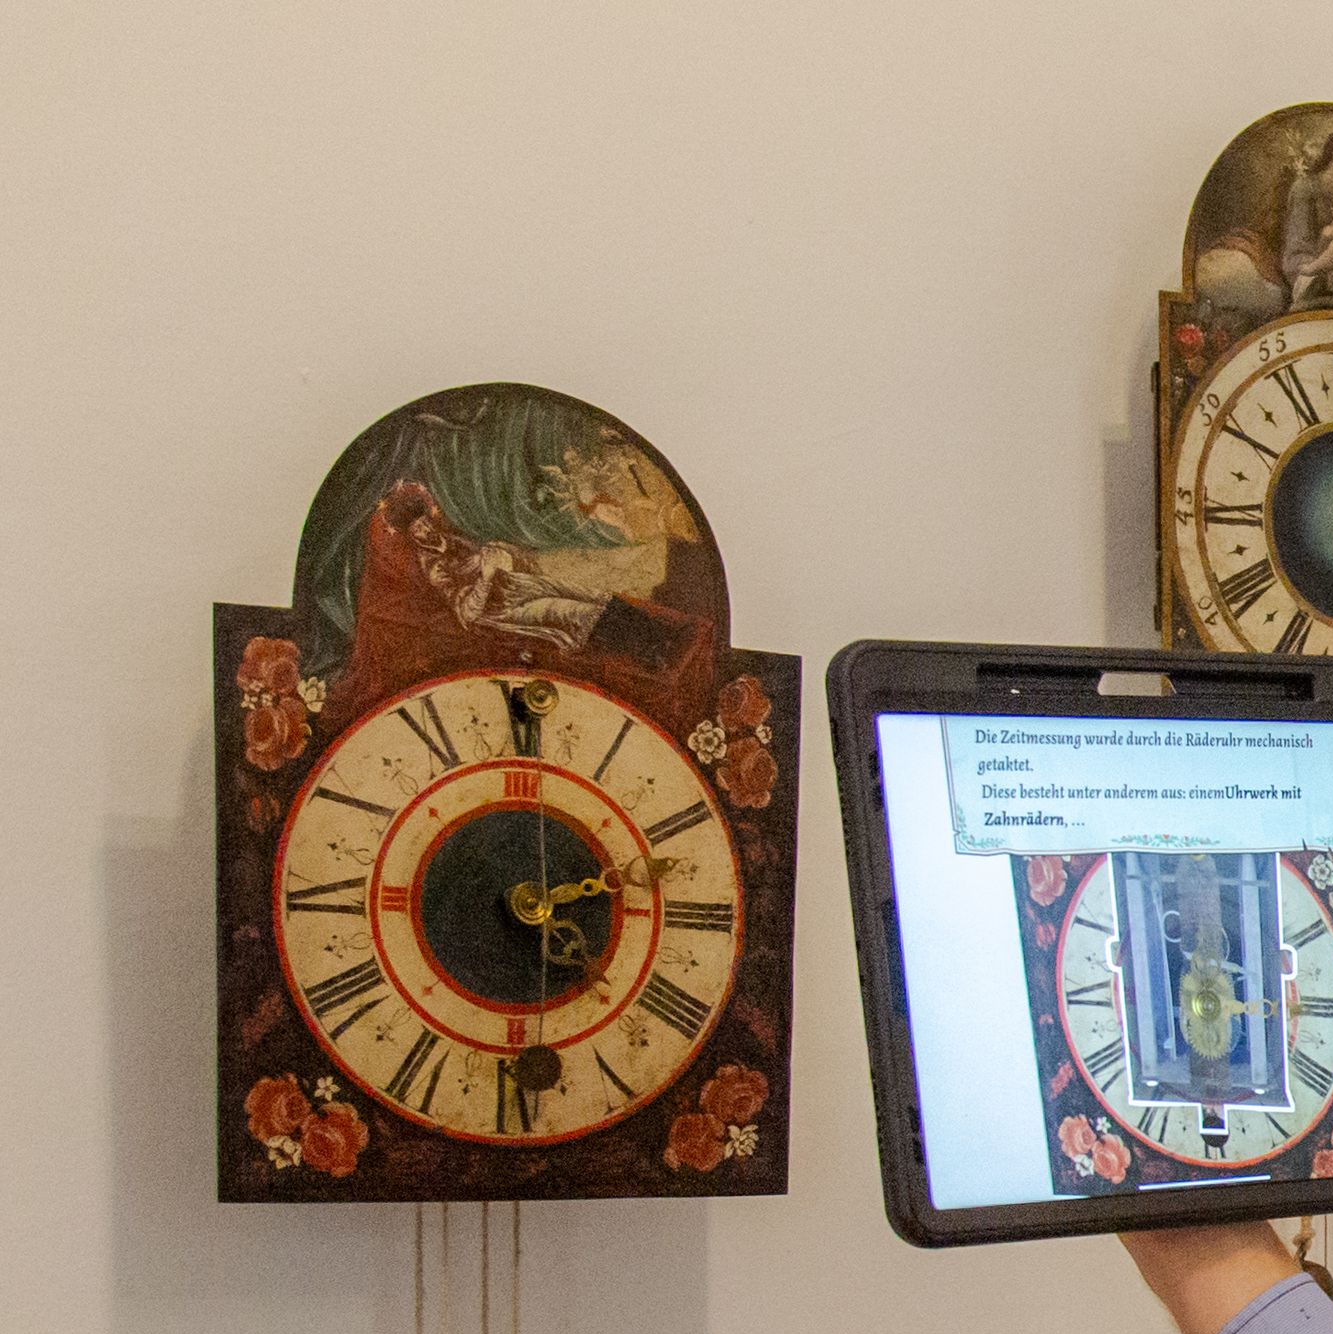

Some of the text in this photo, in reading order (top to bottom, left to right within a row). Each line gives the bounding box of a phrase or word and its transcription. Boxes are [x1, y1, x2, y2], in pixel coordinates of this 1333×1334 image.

[1258, 332, 1287, 361] 55
[975, 729, 1314, 749] Die Zeitmessung wurde durch die Räderuhr mechanisch
[977, 756, 1034, 775] getaktet.
[982, 784, 1016, 799] Diese
[1020, 784, 1064, 799] besteht
[1068, 786, 1102, 799] unter
[1104, 784, 1158, 799] anderem
[1161, 789, 1186, 800] aus:
[1281, 785, 1302, 800] mit
[984, 811, 1068, 828] Zahnrädern,
